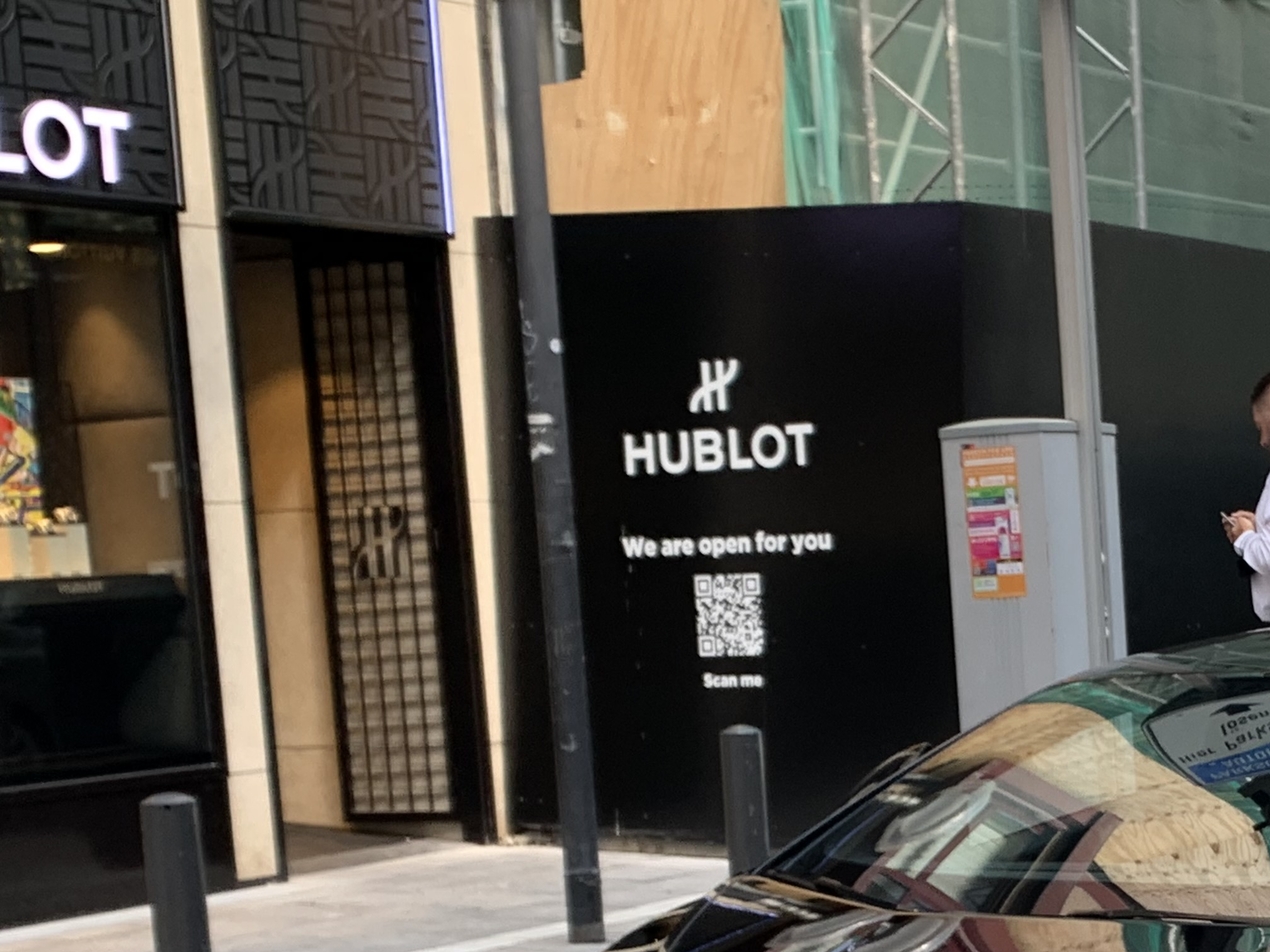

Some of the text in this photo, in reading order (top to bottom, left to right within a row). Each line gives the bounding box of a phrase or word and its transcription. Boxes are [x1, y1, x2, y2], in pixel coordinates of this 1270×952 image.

[622, 422, 816, 476] HUBLOT
[621, 529, 833, 559] We are open for you
[703, 671, 763, 689] Scan me
